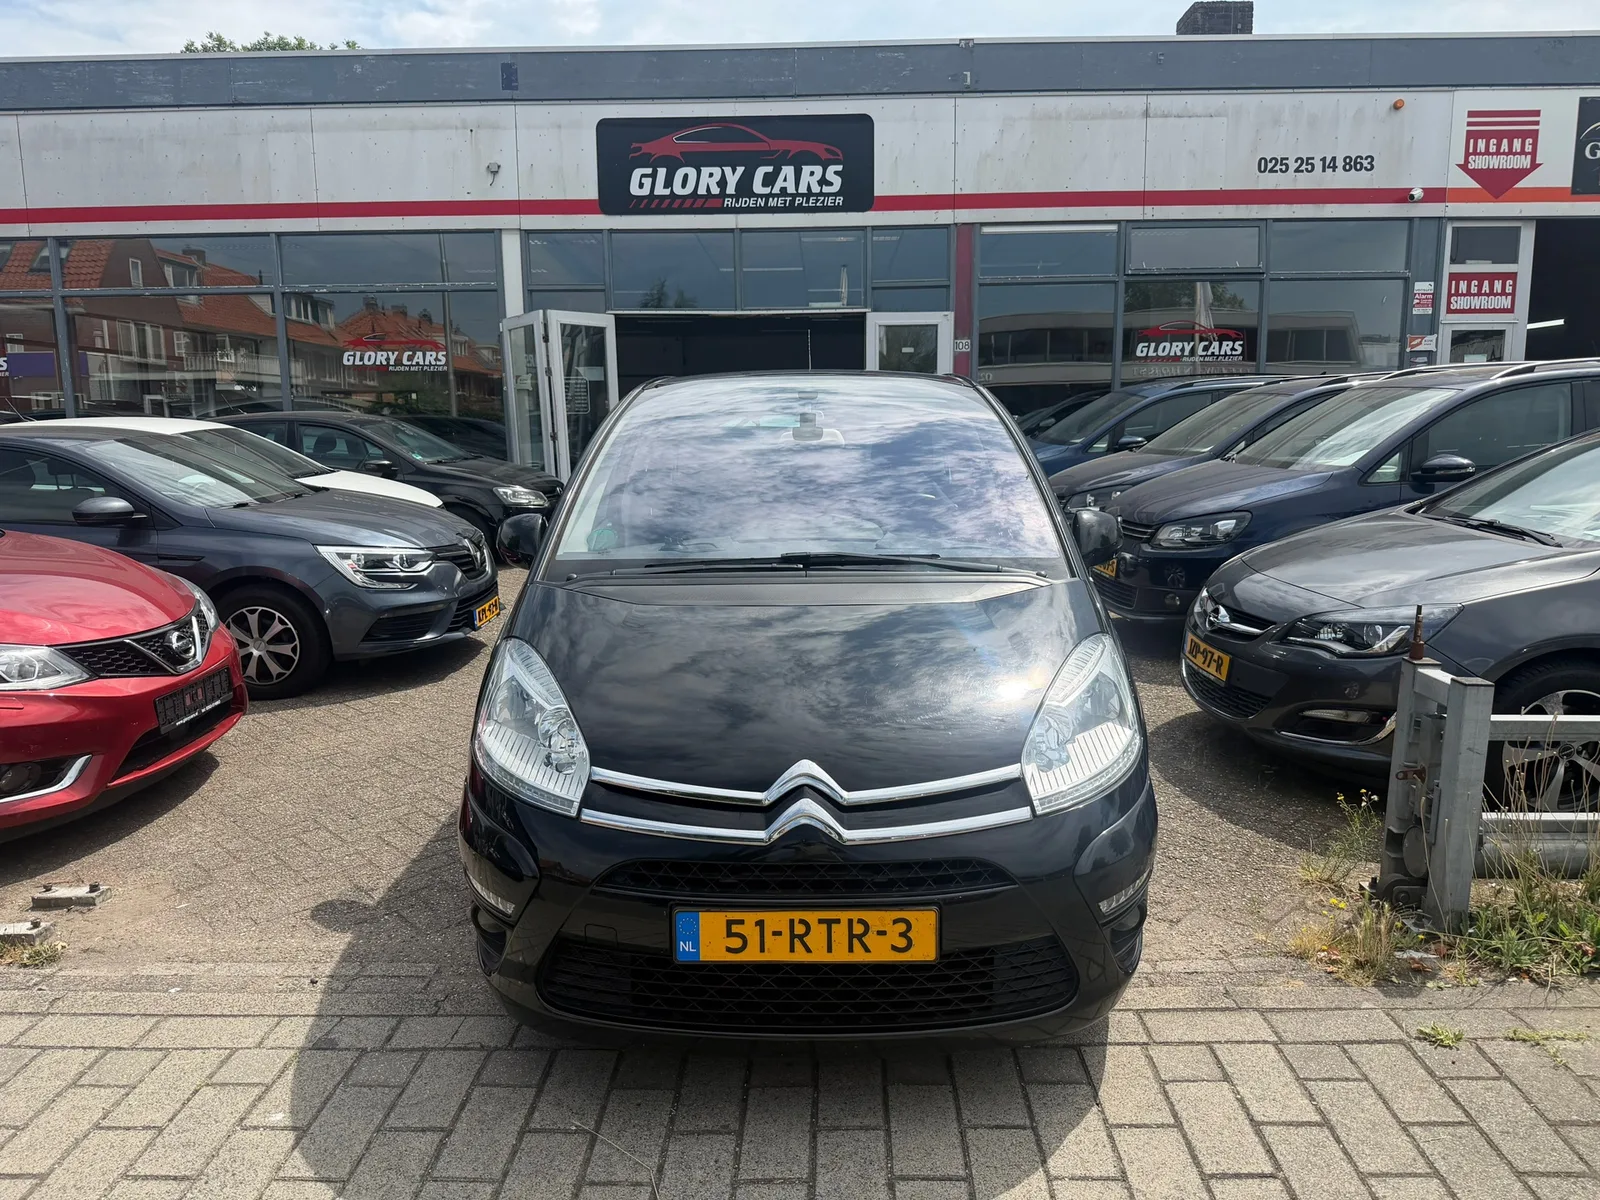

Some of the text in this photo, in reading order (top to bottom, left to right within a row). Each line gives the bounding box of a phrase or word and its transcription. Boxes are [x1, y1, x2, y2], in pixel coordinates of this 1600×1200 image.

[1468, 138, 1533, 153] INGANG
[1257, 154, 1375, 174] 025 25 14 863
[1467, 155, 1532, 169] SHOWROOM
[629, 164, 844, 196] GLORY CARS
[723, 196, 844, 208] RIJDEN MET PLEZIER
[1451, 279, 1513, 294] INGANG
[1450, 295, 1512, 310] SHOWROOM
[955, 341, 970, 351] 108
[1135, 340, 1244, 357] GLORY CARS
[342, 351, 447, 366] GLORY CARS
[725, 917, 914, 954] 51-RTR-3
[680, 940, 697, 952] NL
